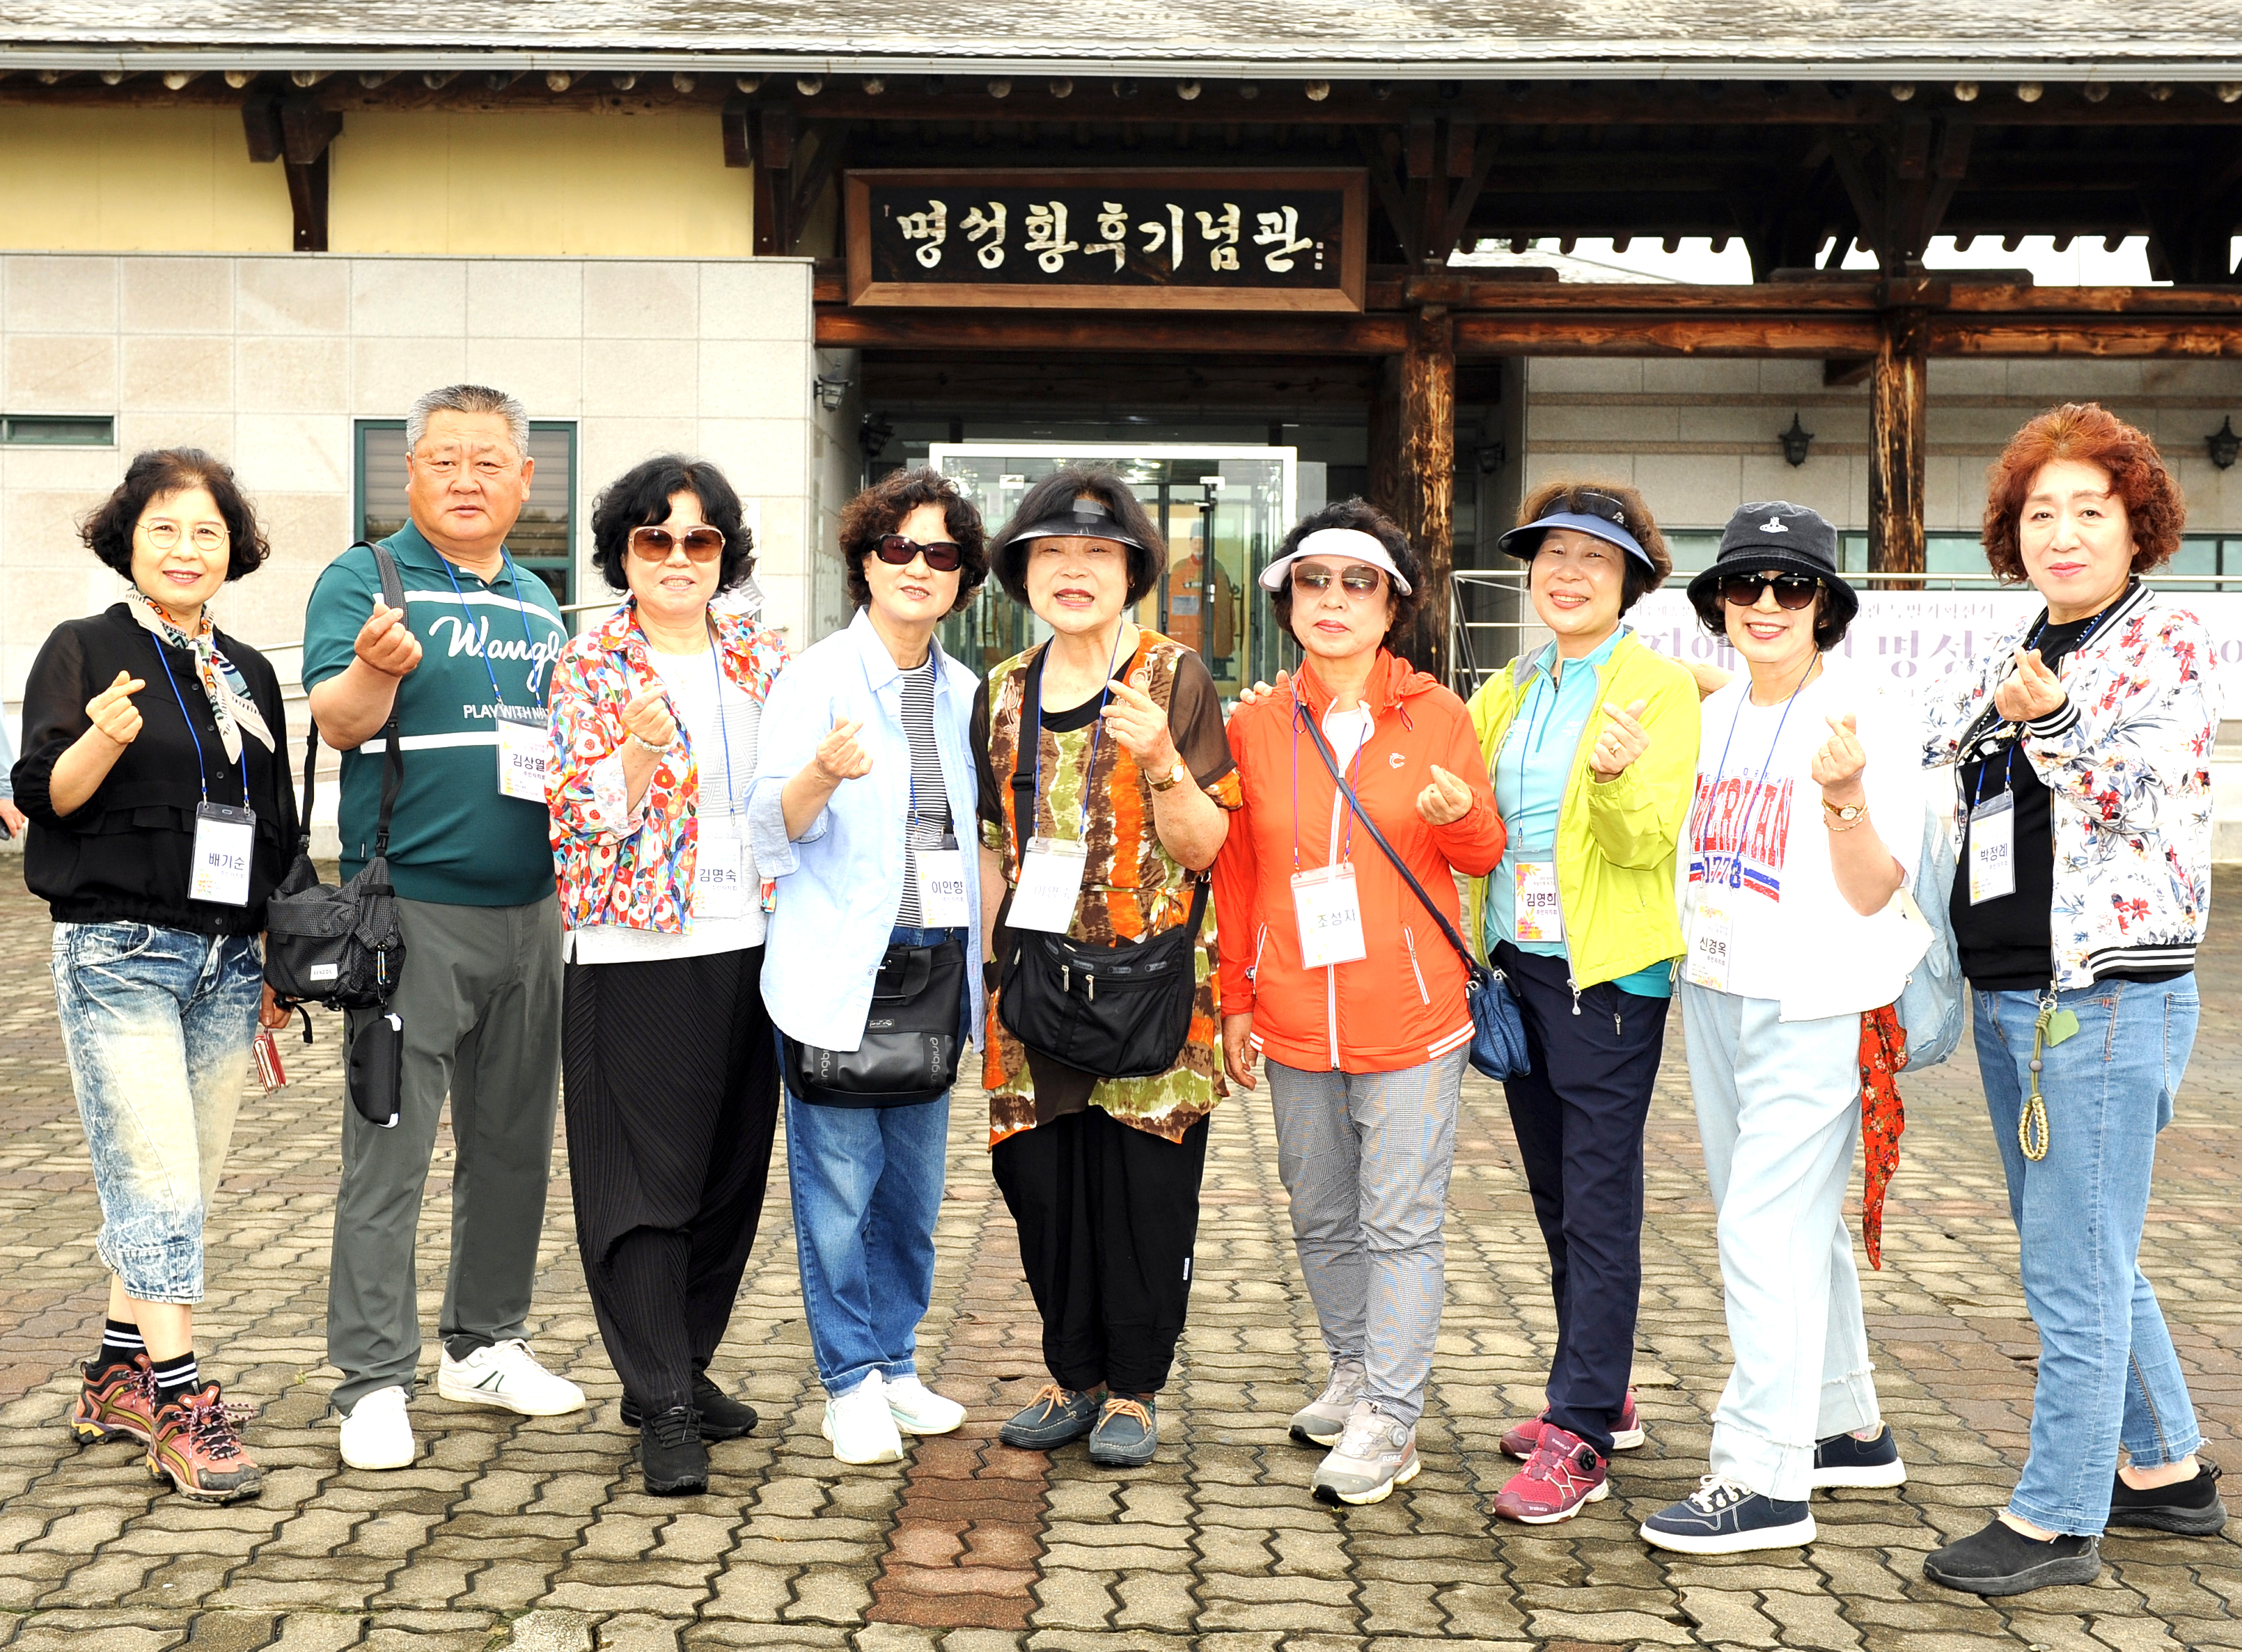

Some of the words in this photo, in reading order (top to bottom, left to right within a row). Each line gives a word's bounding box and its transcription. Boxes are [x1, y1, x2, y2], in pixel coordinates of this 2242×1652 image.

[896, 198, 1313, 273] 명성황후기념관
[463, 705, 496, 718] PLAY
[499, 705, 531, 720] WITH
[512, 753, 545, 772] 김상열
[1691, 773, 1794, 872] MERICAN
[208, 852, 245, 871] 배기순
[699, 868, 737, 883] 김명숙
[1526, 892, 1557, 907] 김영희
[1317, 908, 1356, 929] 조성자
[1699, 936, 1727, 958] 신경옥
